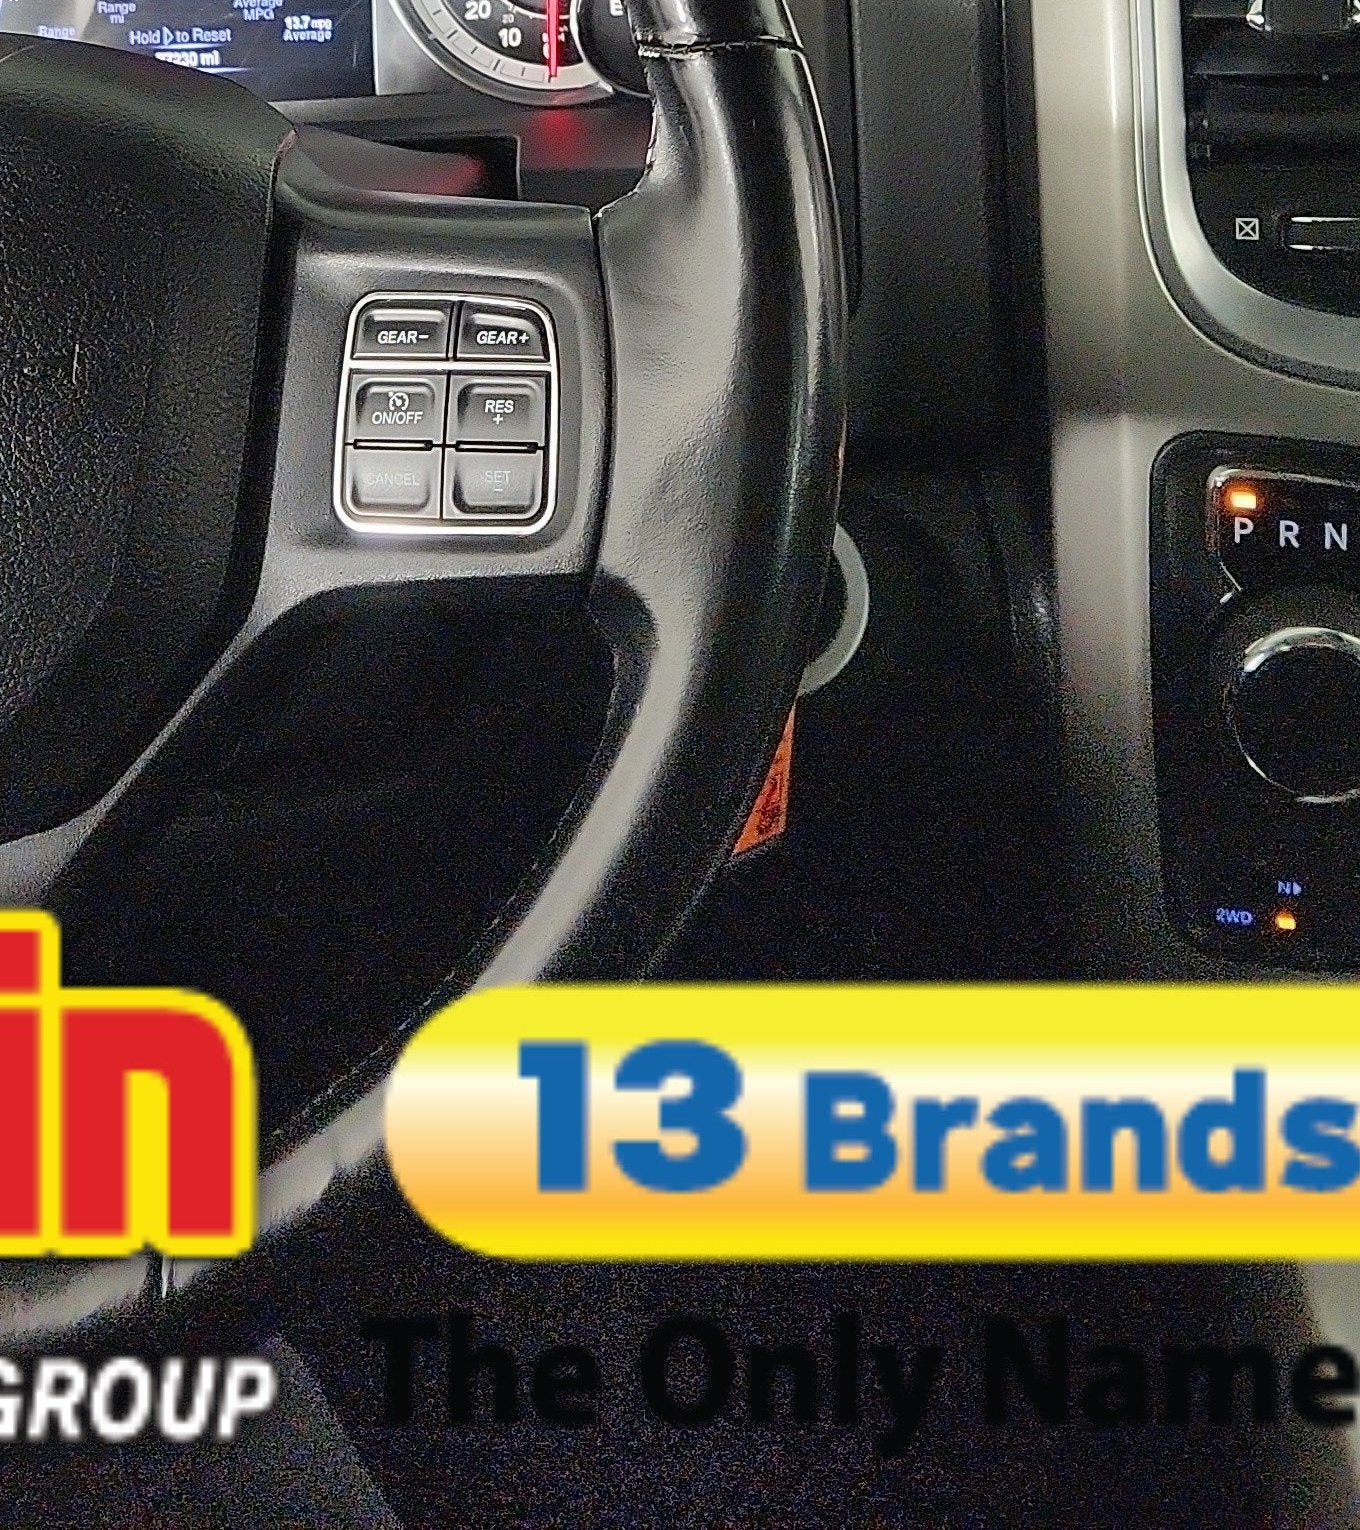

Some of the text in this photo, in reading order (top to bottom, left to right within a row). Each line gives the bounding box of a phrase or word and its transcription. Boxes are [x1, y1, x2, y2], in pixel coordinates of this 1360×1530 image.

[97, 0, 136, 15] Range
[244, 8, 274, 21] MPG
[465, 0, 491, 20] 20
[284, 14, 310, 30] 13.7
[38, 24, 76, 40] Range
[130, 27, 232, 45] Hold to Reset
[283, 29, 332, 43] Average
[498, 28, 521, 47] 10
[485, 400, 514, 414] RES
[372, 411, 423, 425] ON/OFF
[367, 473, 420, 486] CANCEL
[484, 470, 511, 483] SET
[1234, 517, 1254, 544] P
[1279, 520, 1300, 548] R
[1324, 522, 1348, 551] N
